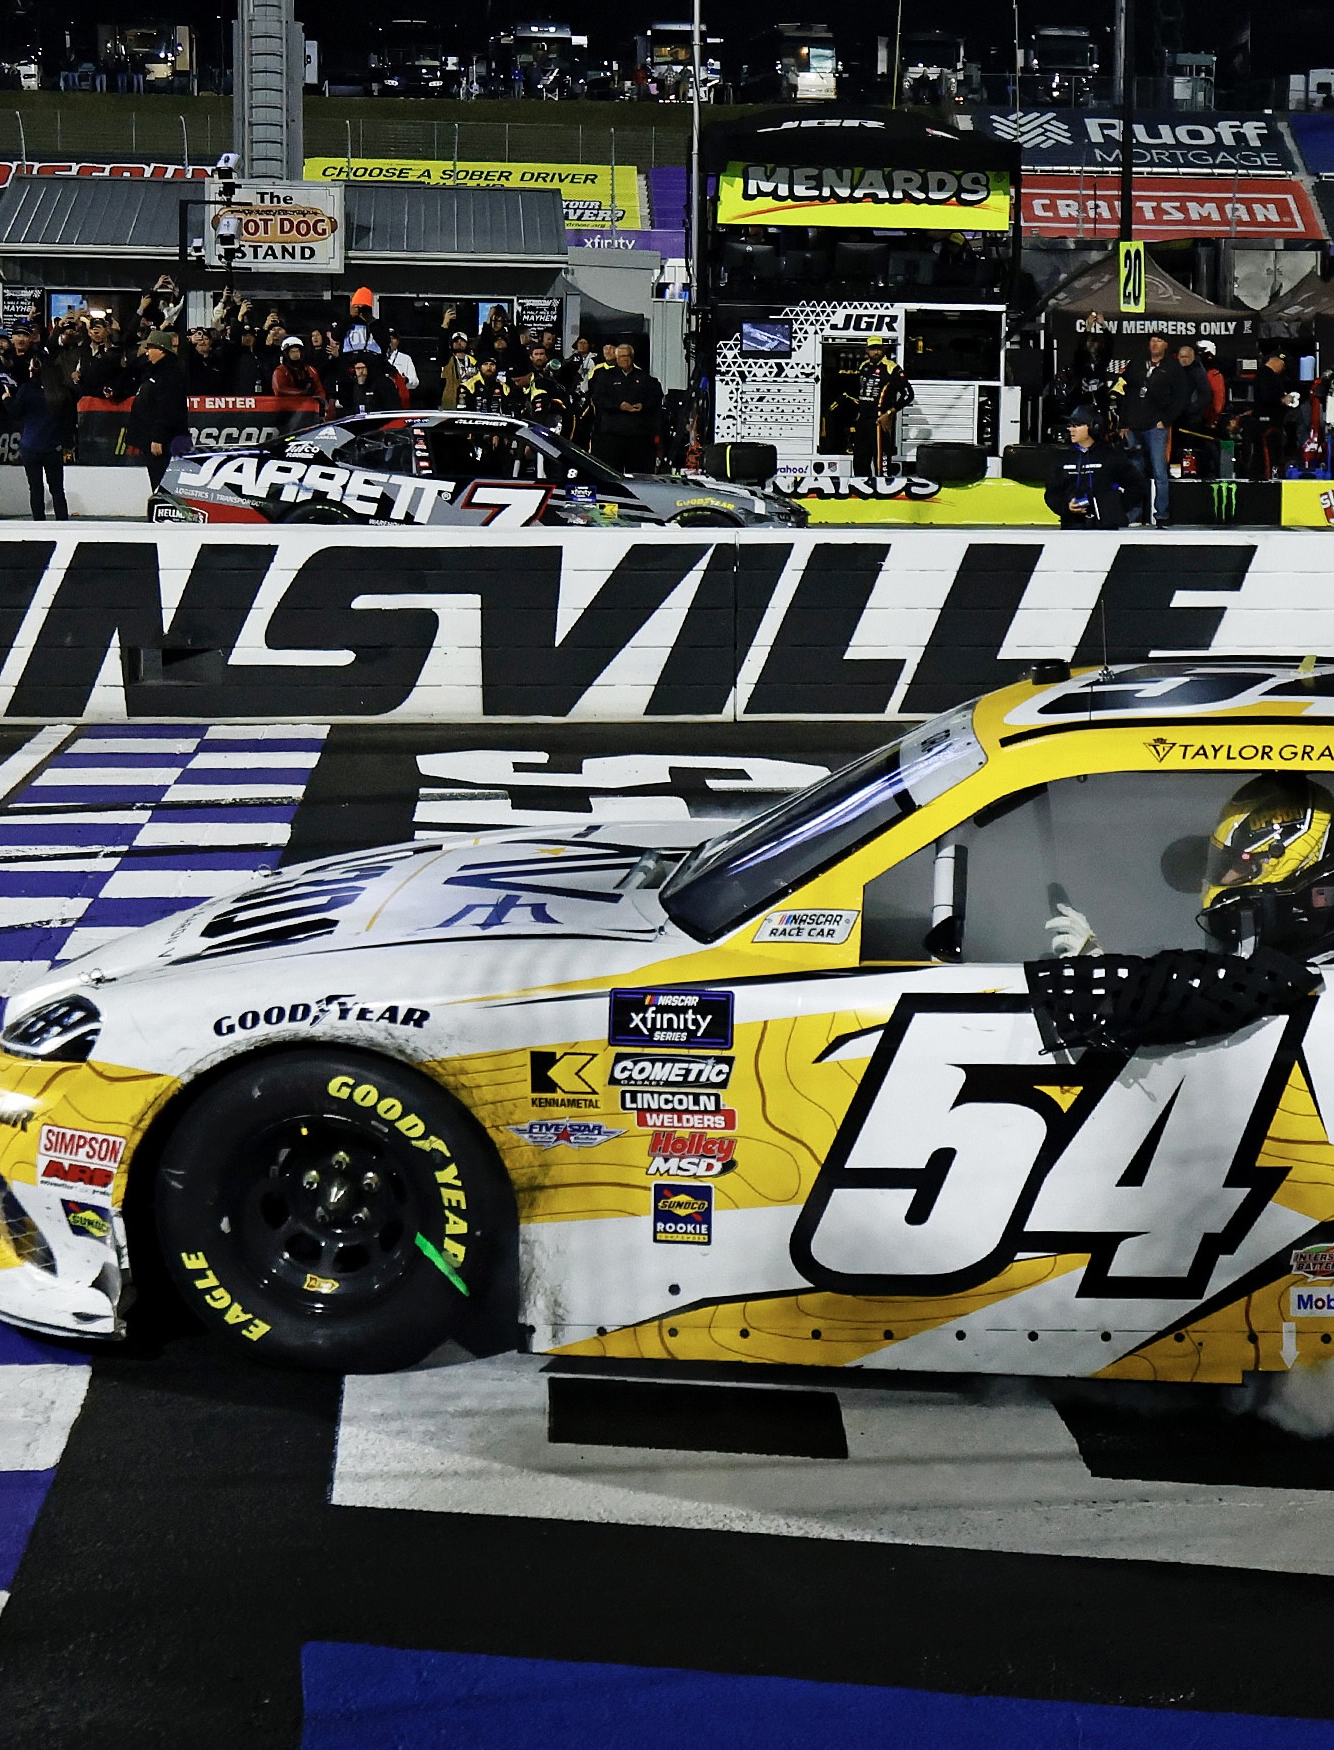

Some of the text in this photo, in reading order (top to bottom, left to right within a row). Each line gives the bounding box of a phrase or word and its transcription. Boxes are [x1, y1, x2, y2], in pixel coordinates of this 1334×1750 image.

[1084, 118, 1268, 147] Ruoff
[1095, 148, 1282, 167] MORTGAGE
[321, 165, 598, 184] CHOOSE A SOBER DRIVER
[746, 165, 989, 201] MENARDS
[256, 191, 294, 205] The
[241, 217, 328, 237] OT DOG
[236, 244, 316, 260] STAND
[1123, 249, 1143, 307] 20
[829, 314, 900, 333] JGR
[1122, 320, 1196, 335] MEMBERS
[1200, 322, 1237, 335] ONLY
[205, 397, 256, 409] ENTER
[178, 456, 456, 525] JARRETT
[466, 484, 554, 527] 7
[1178, 744, 1274, 762] TAYLOR
[790, 913, 844, 926] NASCAR
[769, 927, 836, 938] RACE CAR
[657, 995, 699, 1007] NASCAR
[213, 994, 431, 1038] GOODYEAR
[629, 1007, 713, 1037] xfinity
[652, 1031, 687, 1042] SERIES
[613, 1058, 730, 1082] COMETIC
[531, 1097, 601, 1109] KENNAMETAL
[625, 1092, 716, 1111] LINCOLN
[528, 1122, 603, 1135] FIVE STAR
[646, 1112, 726, 1129] WELDERS
[43, 1128, 123, 1164] SIMPSON
[650, 1131, 736, 1163] Holley
[789, 992, 1320, 1298] 54
[41, 1159, 114, 1188] ARP
[646, 1156, 723, 1177] MSD
[660, 1199, 708, 1210] SUNOCO
[656, 1222, 708, 1234] ROOKIE
[180, 1250, 273, 1342] EAGLE
